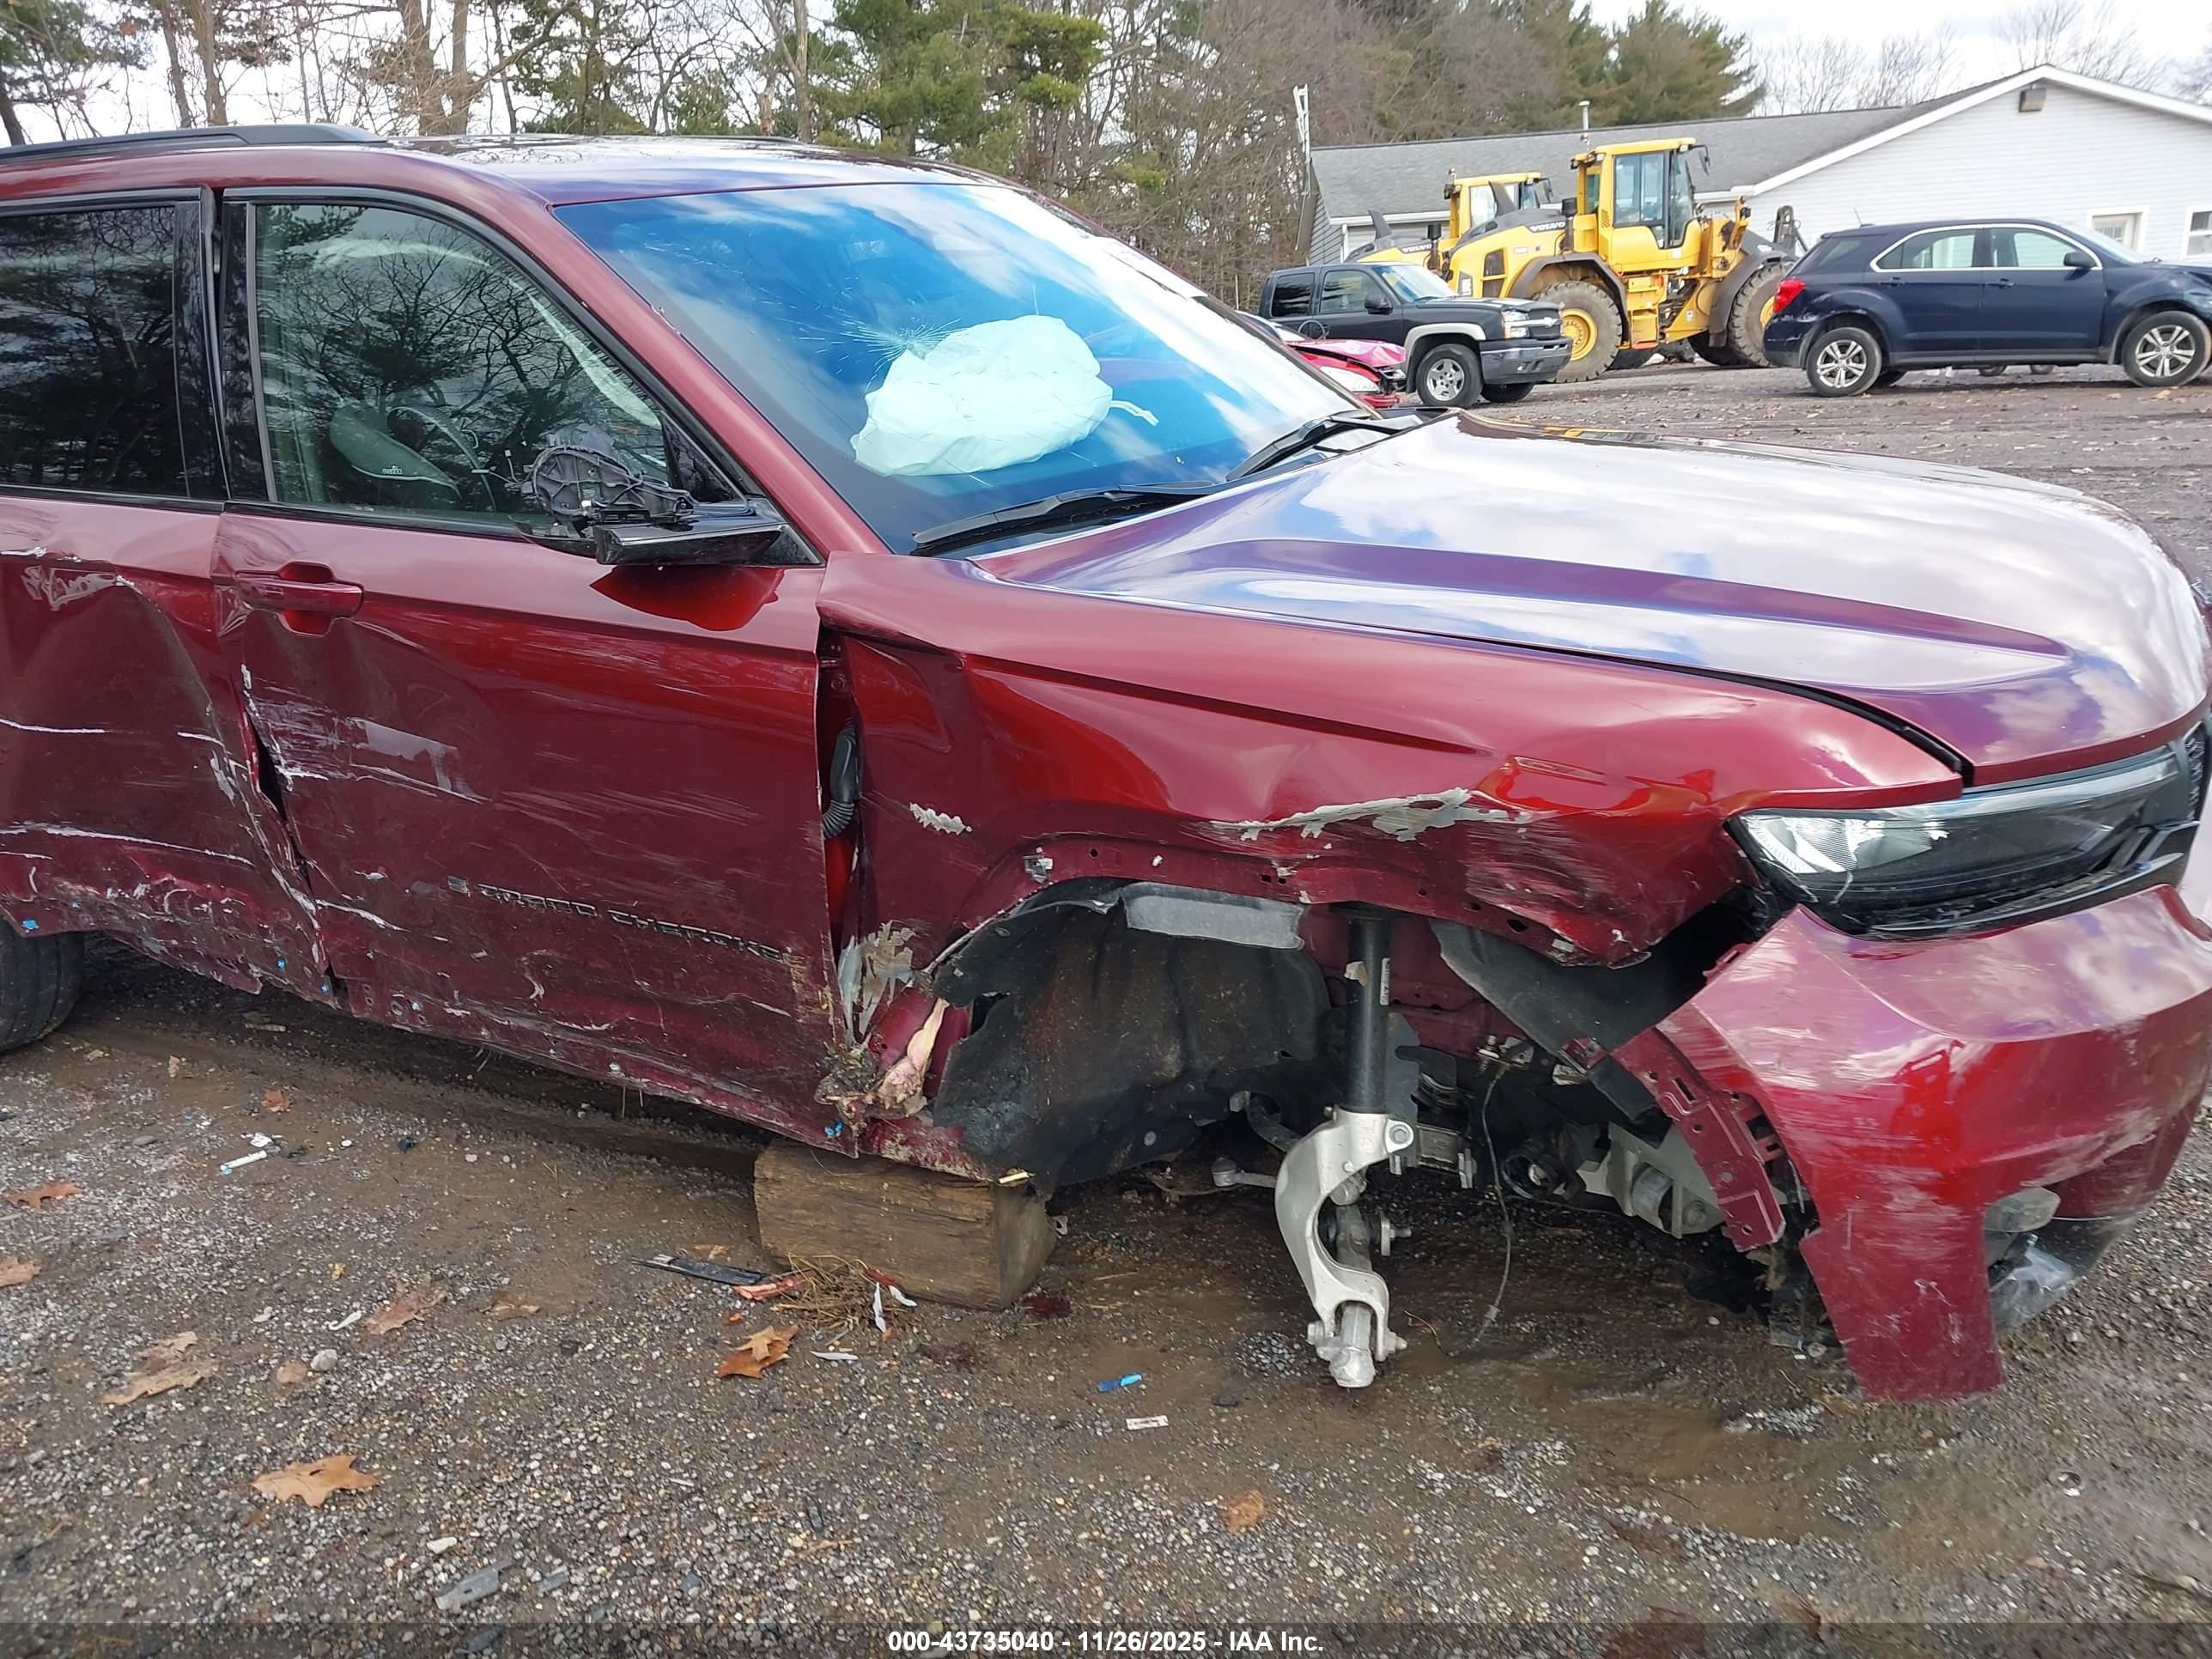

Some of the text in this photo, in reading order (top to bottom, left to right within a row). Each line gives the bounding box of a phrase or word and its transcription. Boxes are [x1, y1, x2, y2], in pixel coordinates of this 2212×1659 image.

[1529, 222, 1565, 232] VOLVO
[1401, 243, 1432, 253] VOLVO
[477, 883, 600, 916] GRAND
